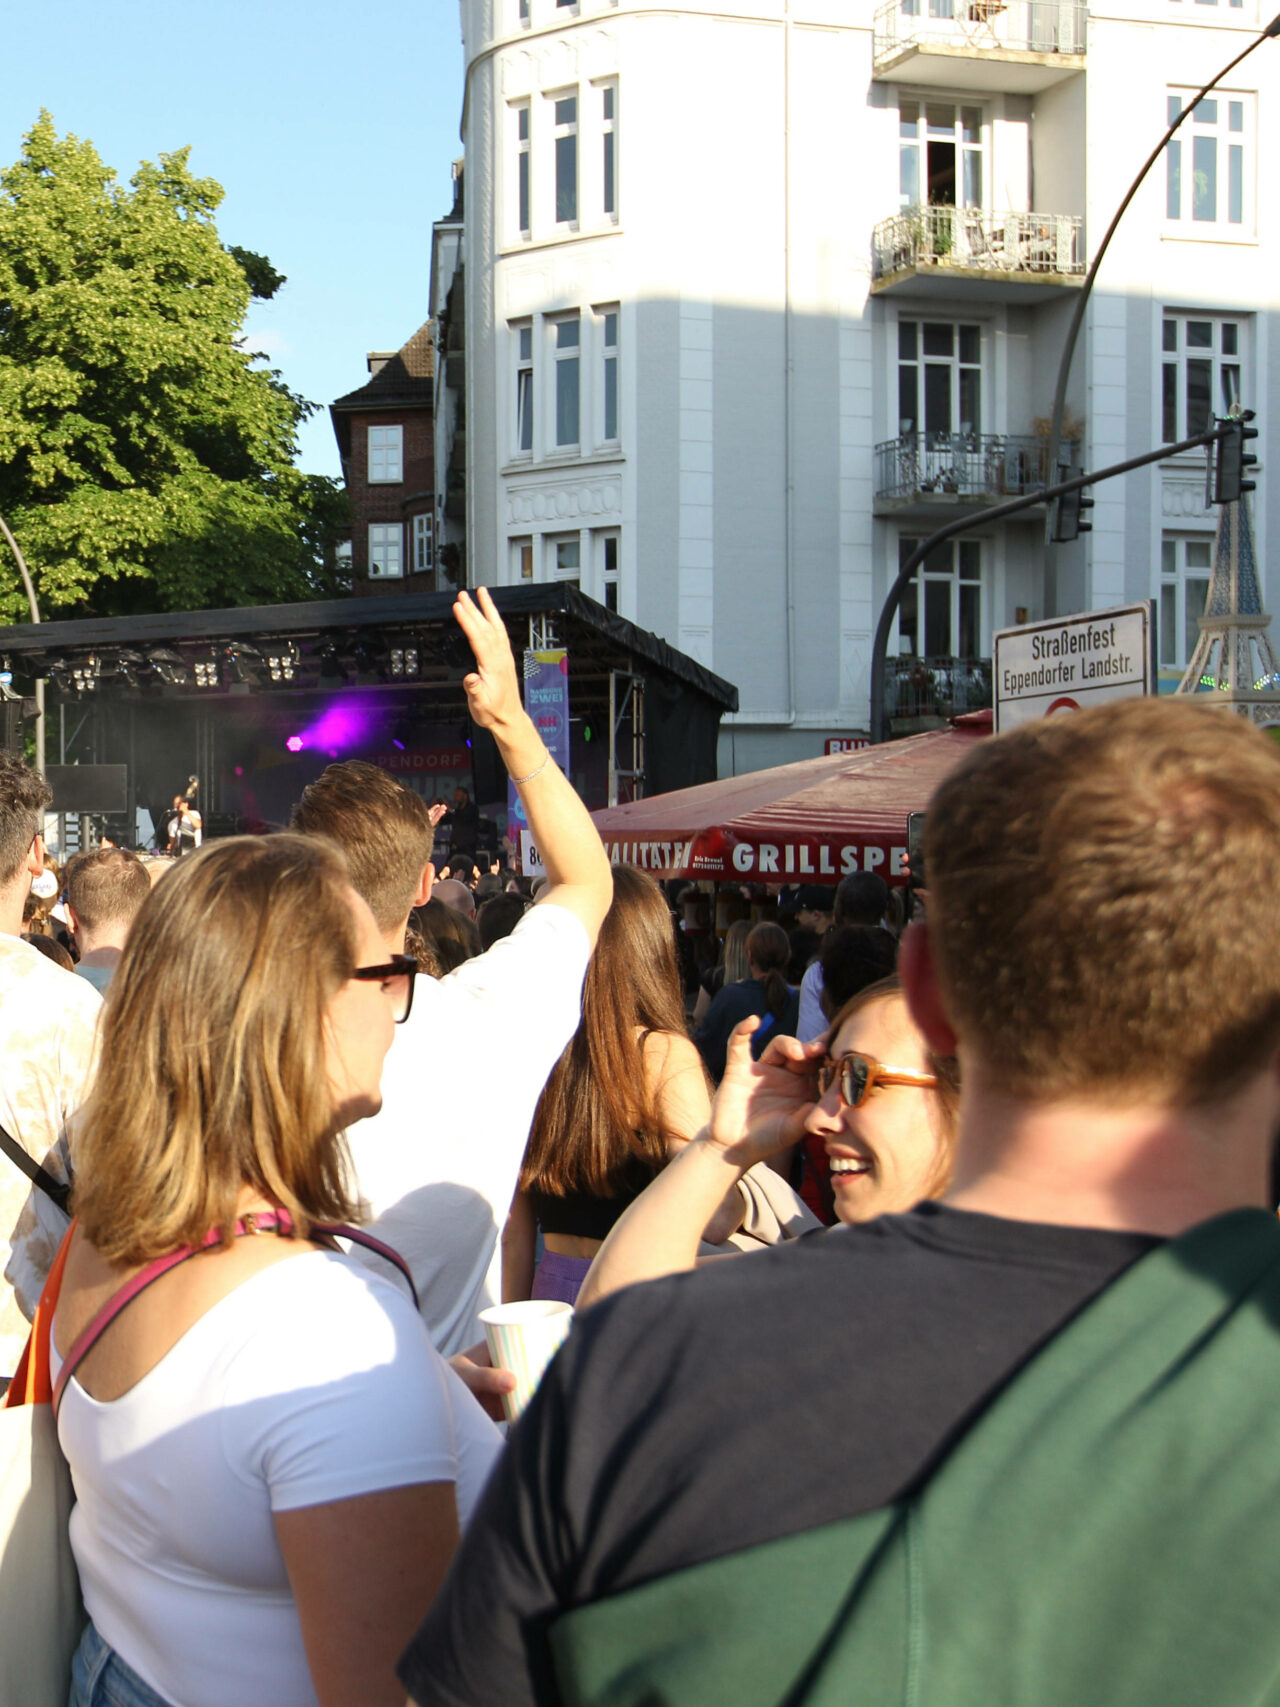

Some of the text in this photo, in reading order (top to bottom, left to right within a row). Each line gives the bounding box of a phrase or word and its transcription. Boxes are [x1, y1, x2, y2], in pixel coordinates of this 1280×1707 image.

[1031, 622, 1116, 661] Straßenfest
[1003, 652, 1134, 696] Eppendorfer Landstr.
[529, 693, 564, 704] ZWEI
